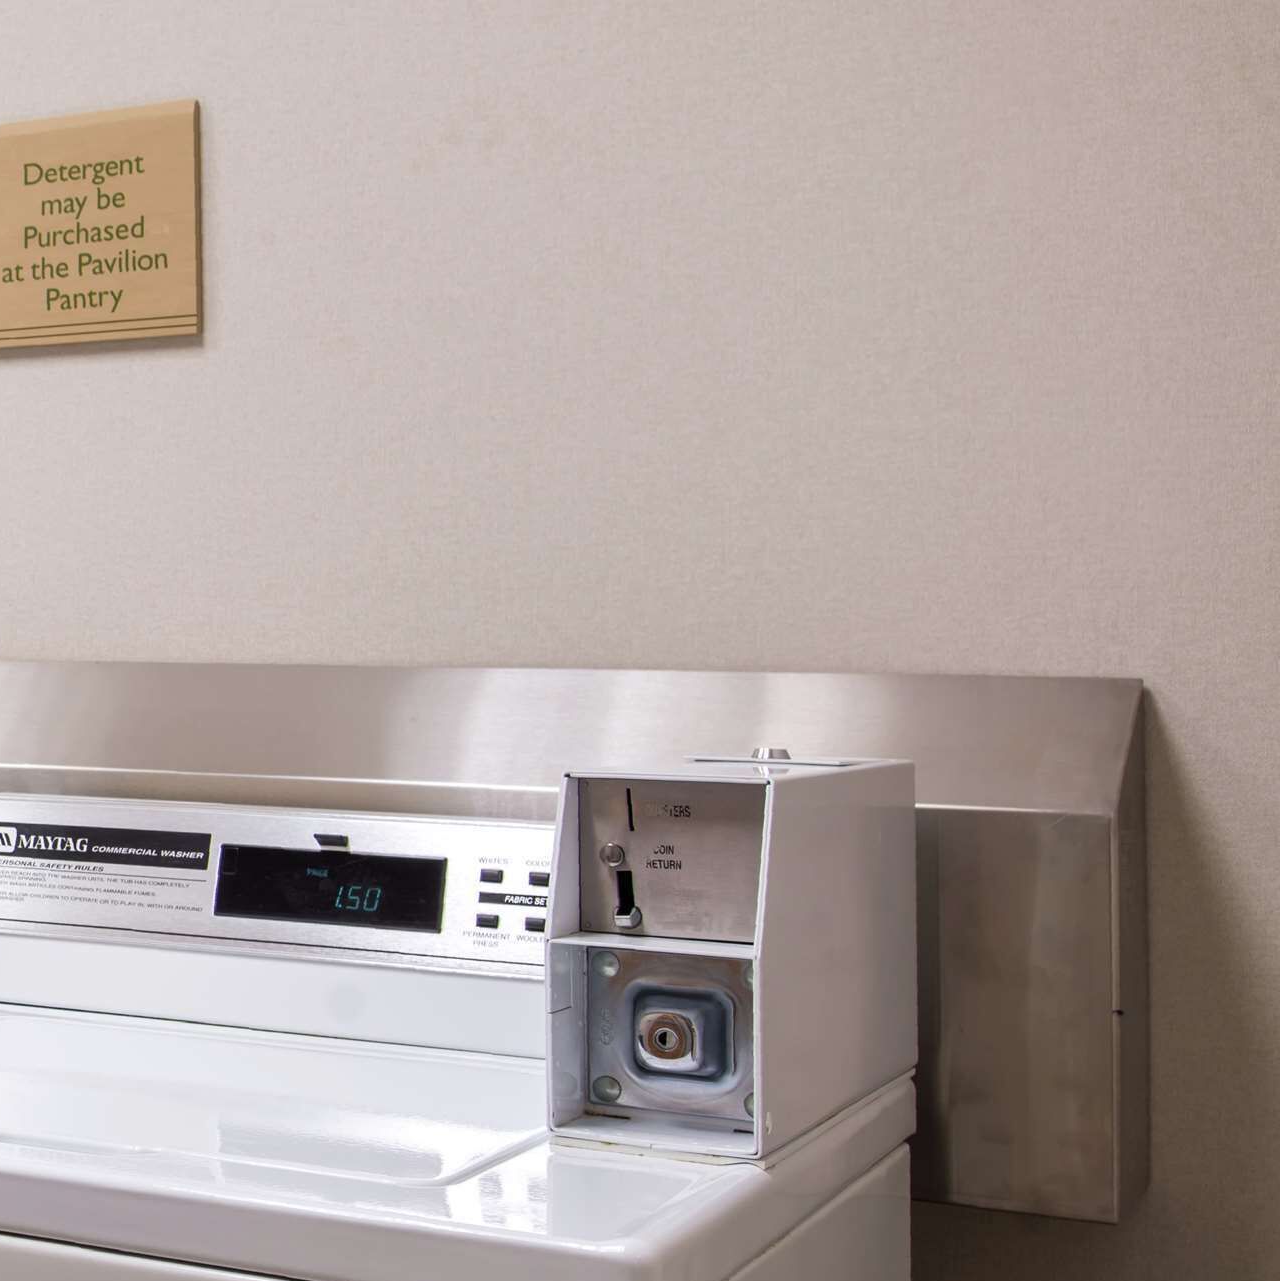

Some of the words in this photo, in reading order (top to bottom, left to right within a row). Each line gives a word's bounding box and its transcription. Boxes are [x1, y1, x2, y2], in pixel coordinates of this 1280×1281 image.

[23, 155, 145, 186] Detergent
[41, 195, 88, 219] may
[96, 187, 126, 210] be
[23, 215, 145, 249] Purchased
[1, 264, 25, 283] at
[31, 257, 69, 280] the
[77, 249, 169, 276] Pavilion
[46, 287, 123, 313] Pantry
[18, 834, 89, 853] MAYTAG
[91, 845, 158, 857] COMMERCIAL
[160, 849, 205, 859] WASHER
[39, 862, 73, 870] SAFETY
[646, 859, 682, 870] RETURN
[334, 885, 382, 912] 1.50
[504, 894, 533, 905] FABRIC
[462, 930, 510, 941] PERMANENT
